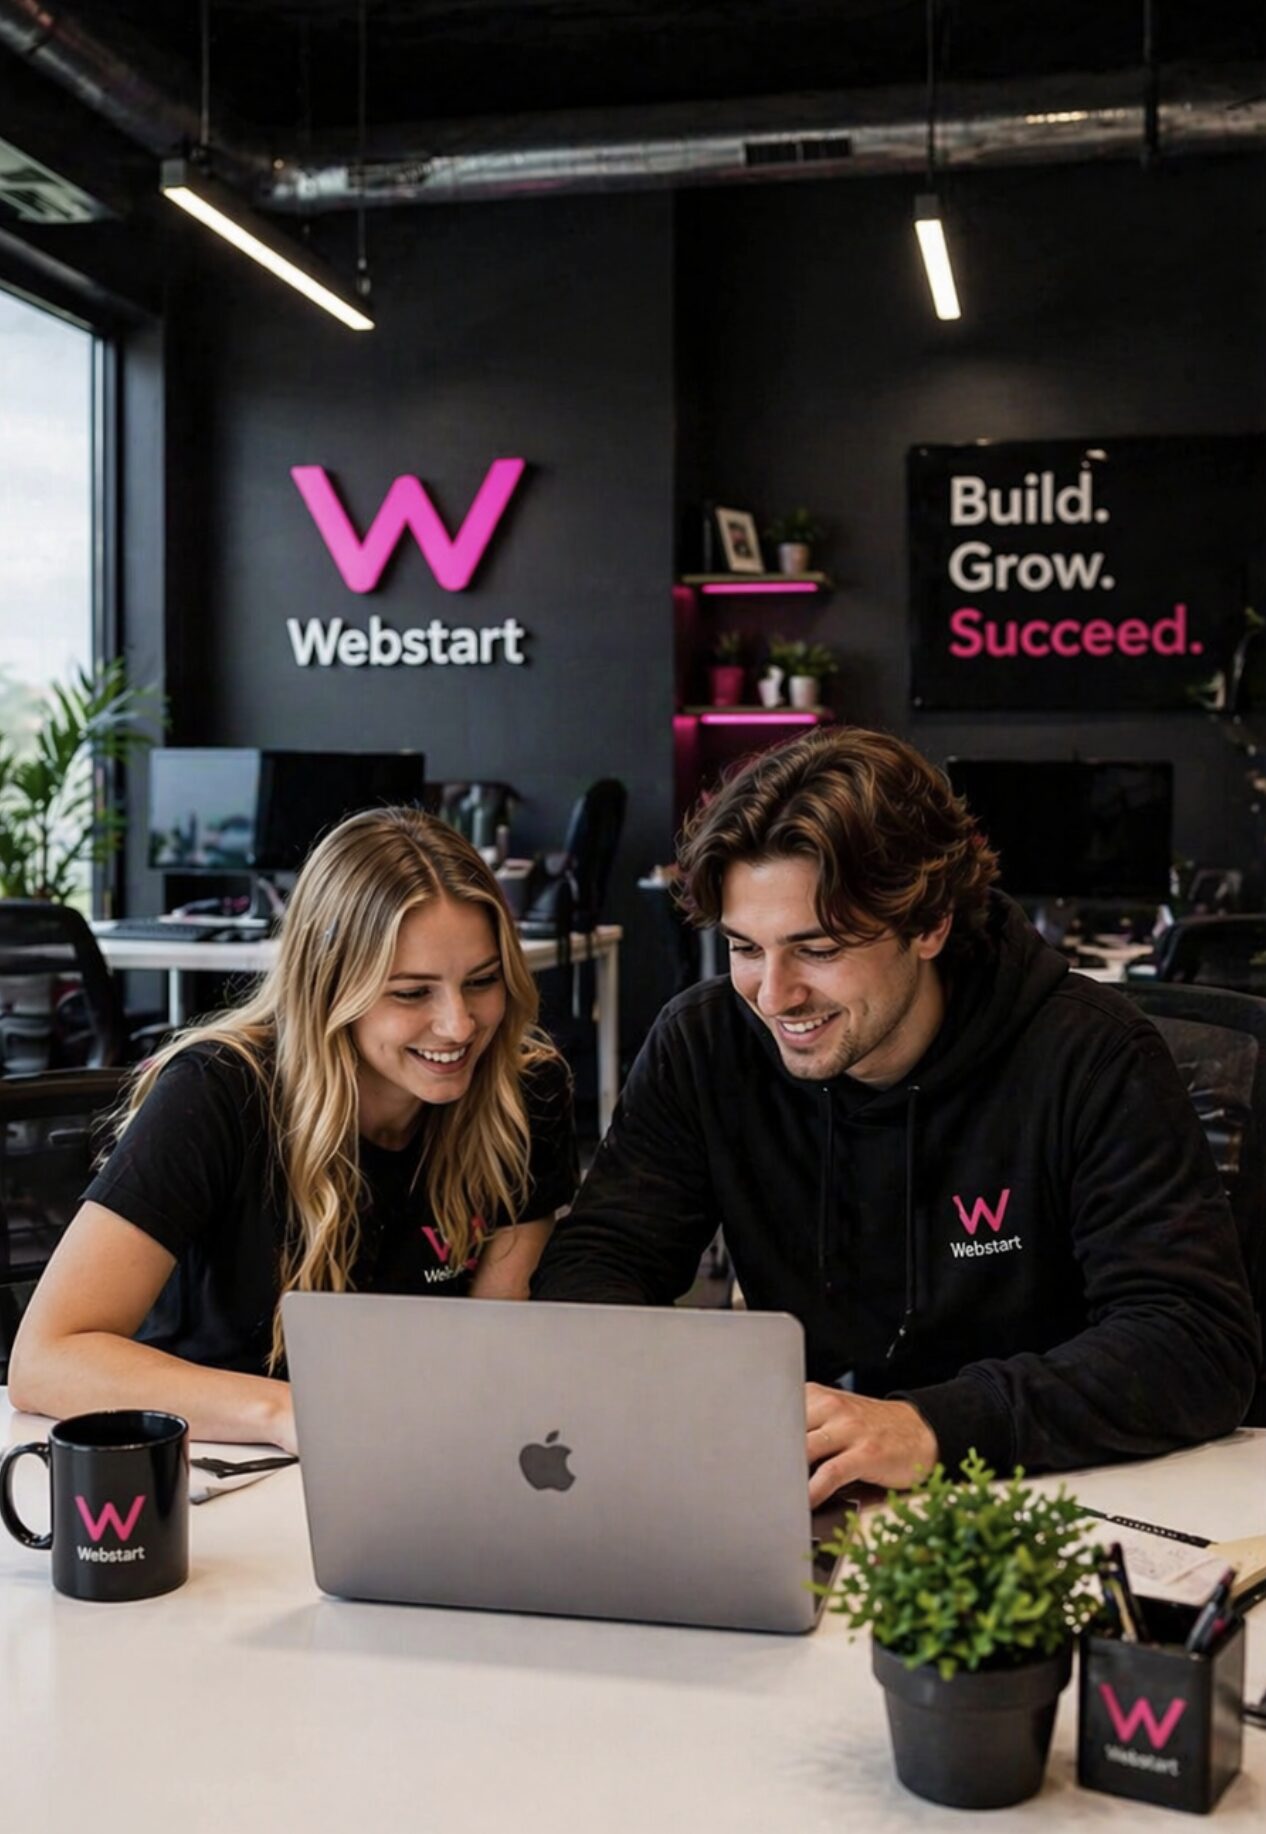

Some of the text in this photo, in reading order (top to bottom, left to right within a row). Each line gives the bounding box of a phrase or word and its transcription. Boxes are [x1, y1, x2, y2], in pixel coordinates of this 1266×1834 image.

[950, 471, 1109, 525] Build.
[290, 457, 525, 593] W
[949, 541, 1115, 591] Grow.
[286, 615, 525, 666] Webstart
[950, 603, 1203, 656] Succeed.
[952, 1188, 1010, 1235] W
[950, 1235, 1022, 1258] Webstart
[74, 1494, 146, 1542] W
[76, 1545, 145, 1563] Webstart
[1099, 1682, 1186, 1749] W
